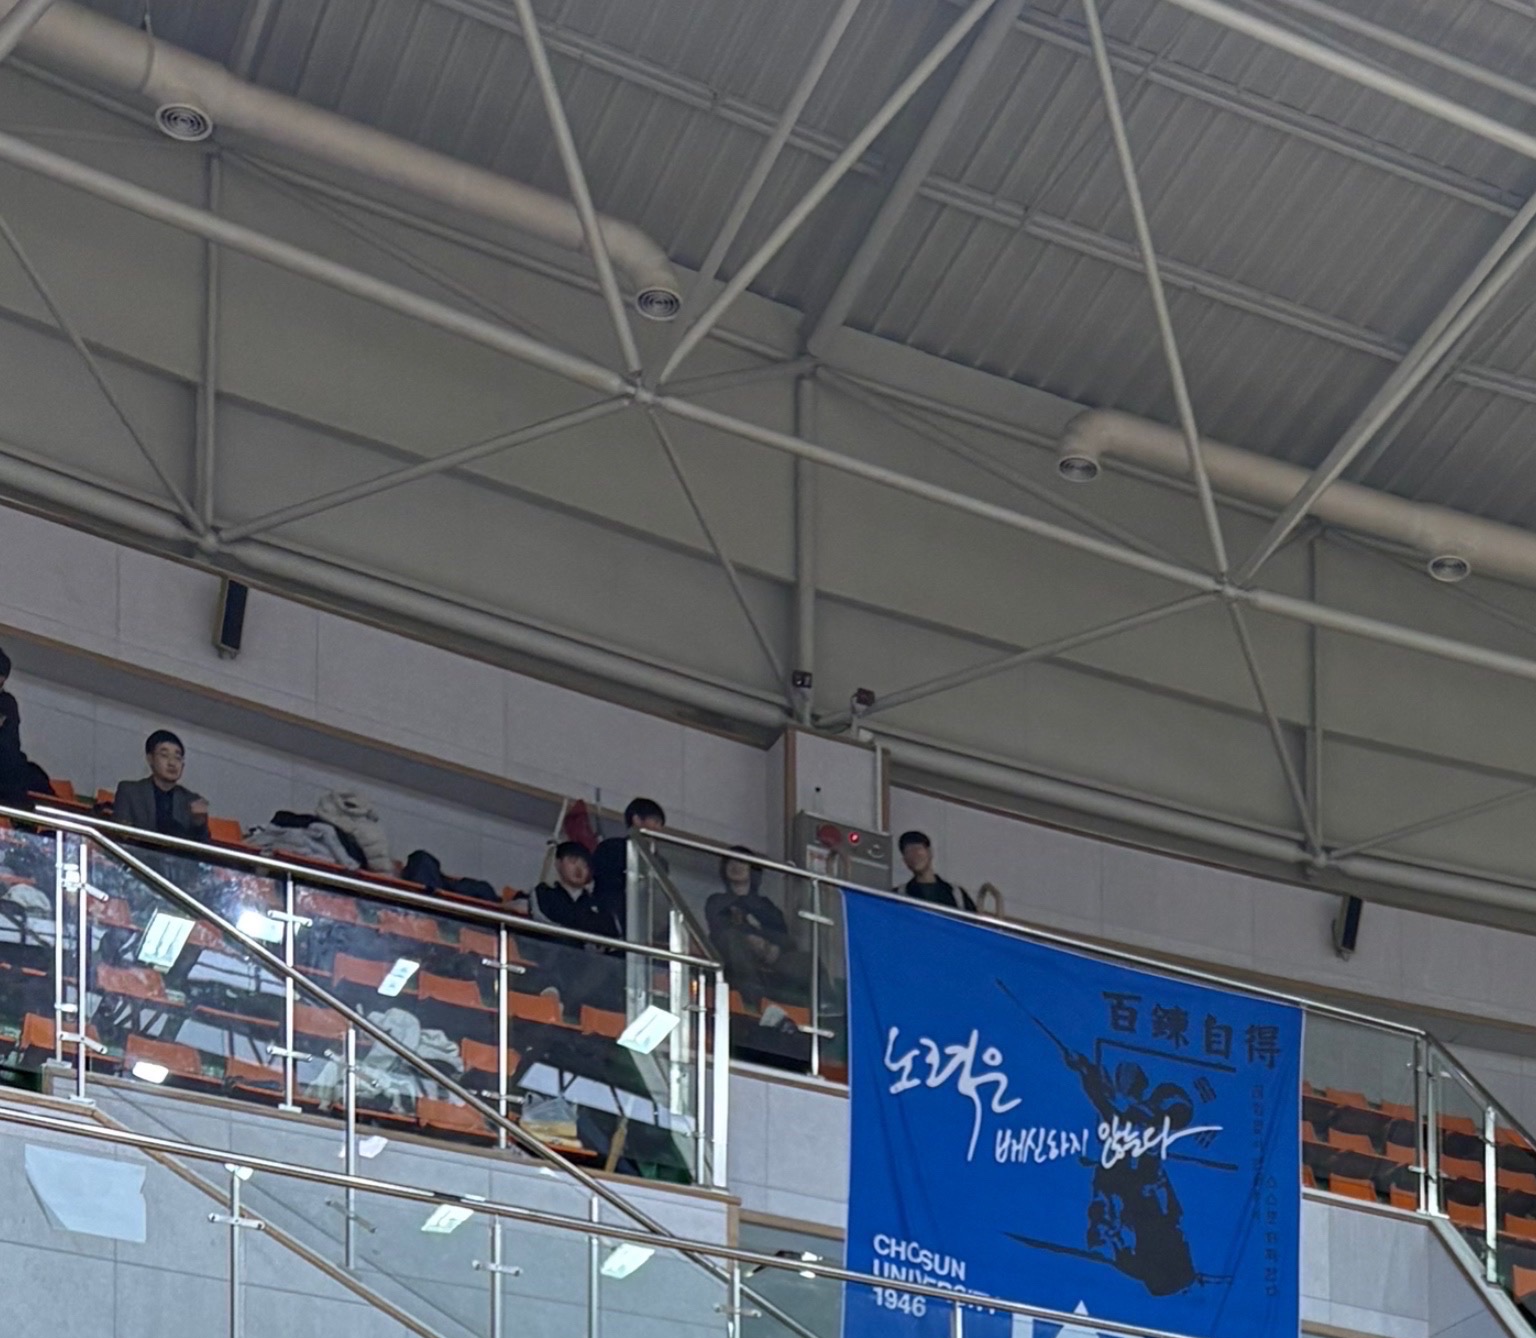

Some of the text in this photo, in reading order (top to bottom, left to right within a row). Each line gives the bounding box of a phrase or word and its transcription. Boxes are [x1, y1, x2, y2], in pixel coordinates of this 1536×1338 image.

[1103, 990, 1281, 1069] 百鍊自得
[884, 1026, 1022, 1162] 노력은
[873, 1234, 966, 1281] CHOSUN
[873, 1286, 927, 1317] 1946
